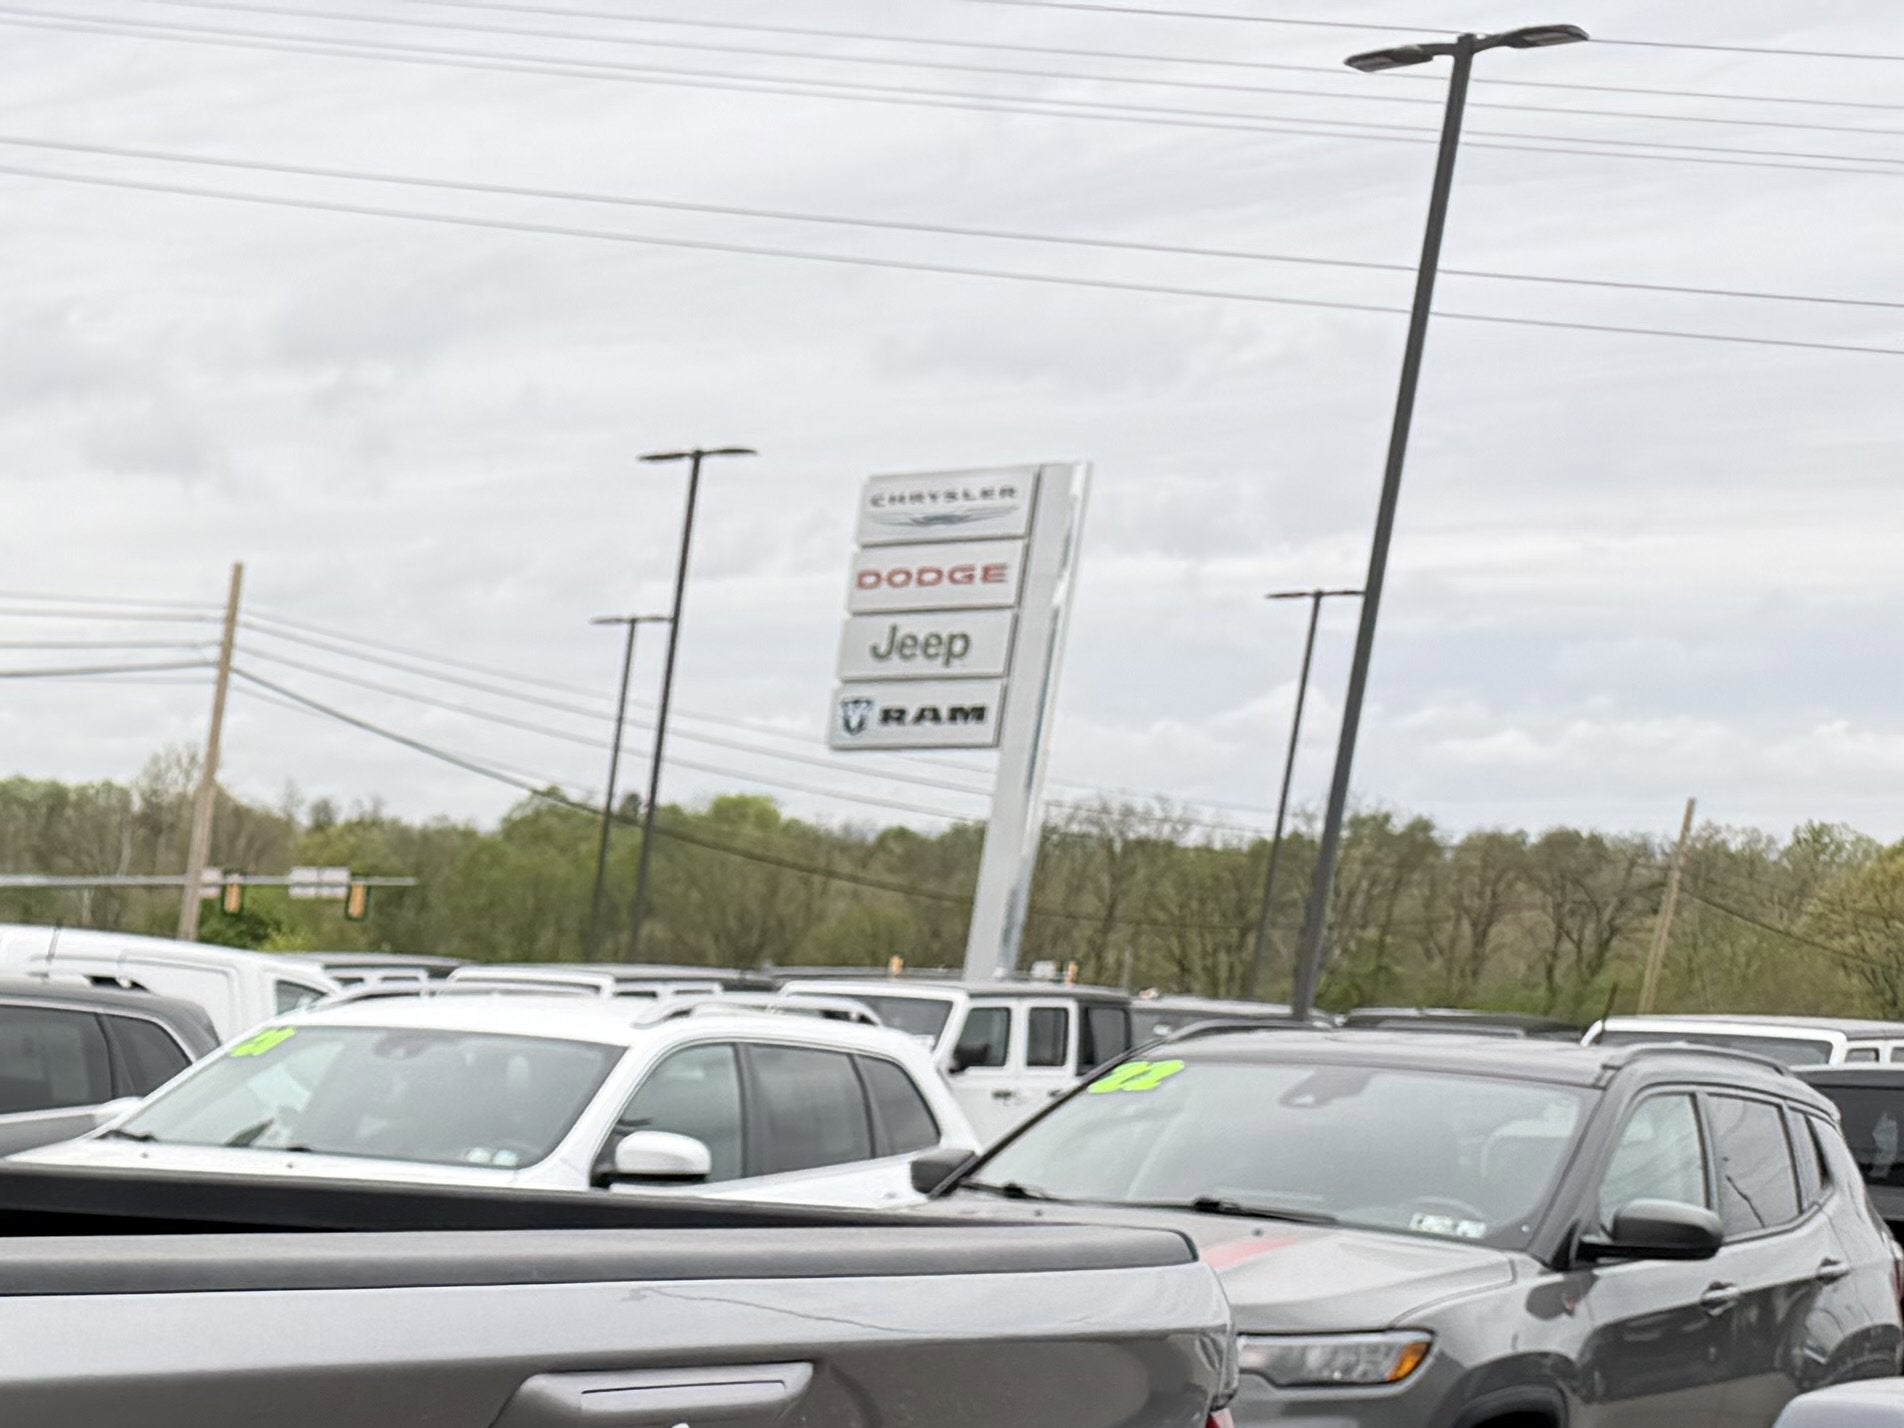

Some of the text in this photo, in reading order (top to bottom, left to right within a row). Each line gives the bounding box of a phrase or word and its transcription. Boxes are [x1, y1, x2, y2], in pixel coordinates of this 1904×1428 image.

[869, 484, 1017, 509] CHRYSLER
[856, 562, 1009, 591] DODGE
[870, 624, 971, 668] Jeep
[878, 704, 987, 727] RAM
